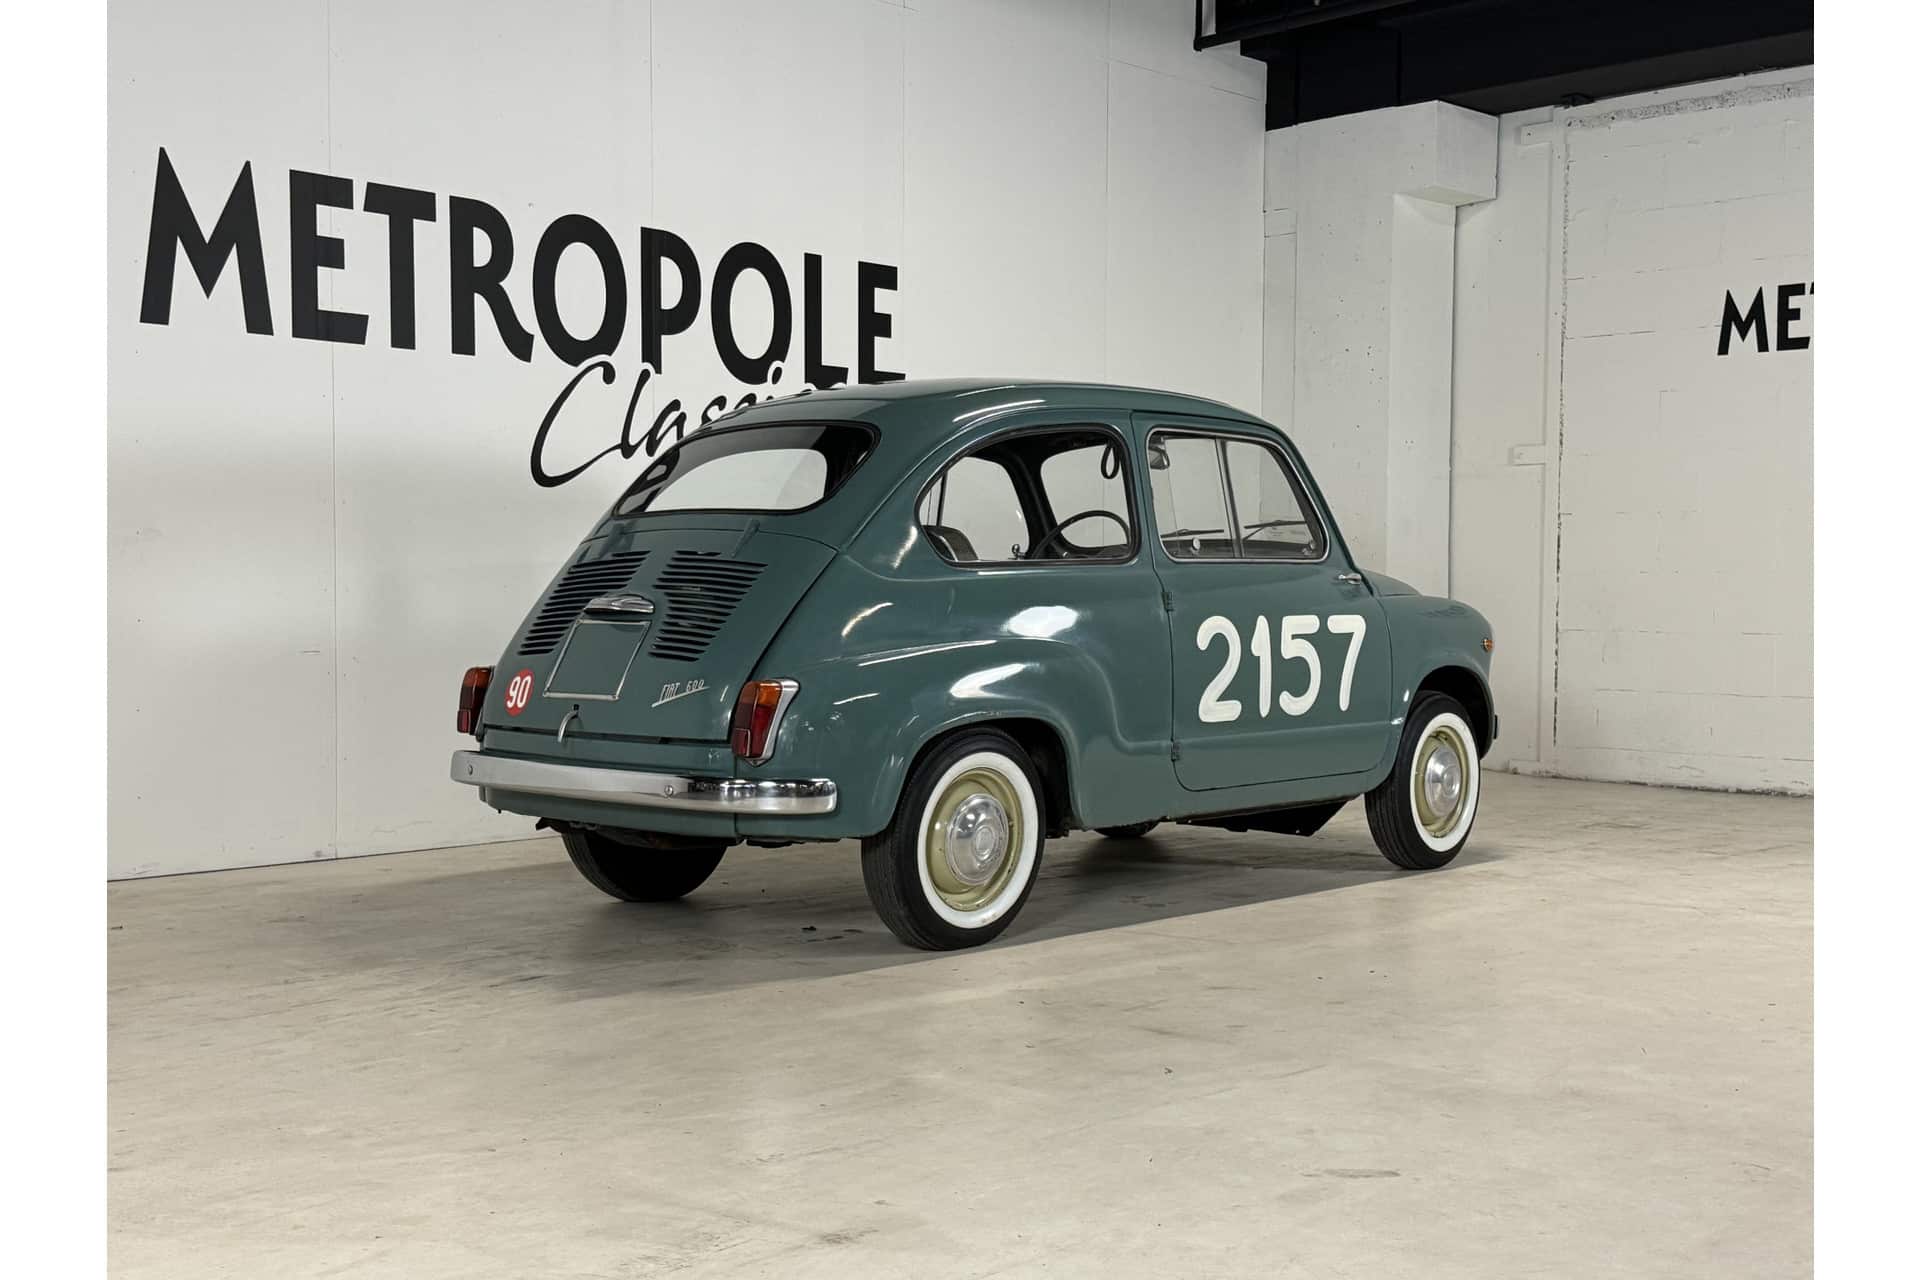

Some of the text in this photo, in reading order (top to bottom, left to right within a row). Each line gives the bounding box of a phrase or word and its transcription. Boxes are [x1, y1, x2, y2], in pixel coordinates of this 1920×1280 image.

[139, 146, 907, 388] METROPOLE
[1717, 281, 1814, 356] ME
[506, 675, 531, 708] 90
[659, 679, 705, 702] FIAT 600
[1197, 614, 1366, 723] 2157
